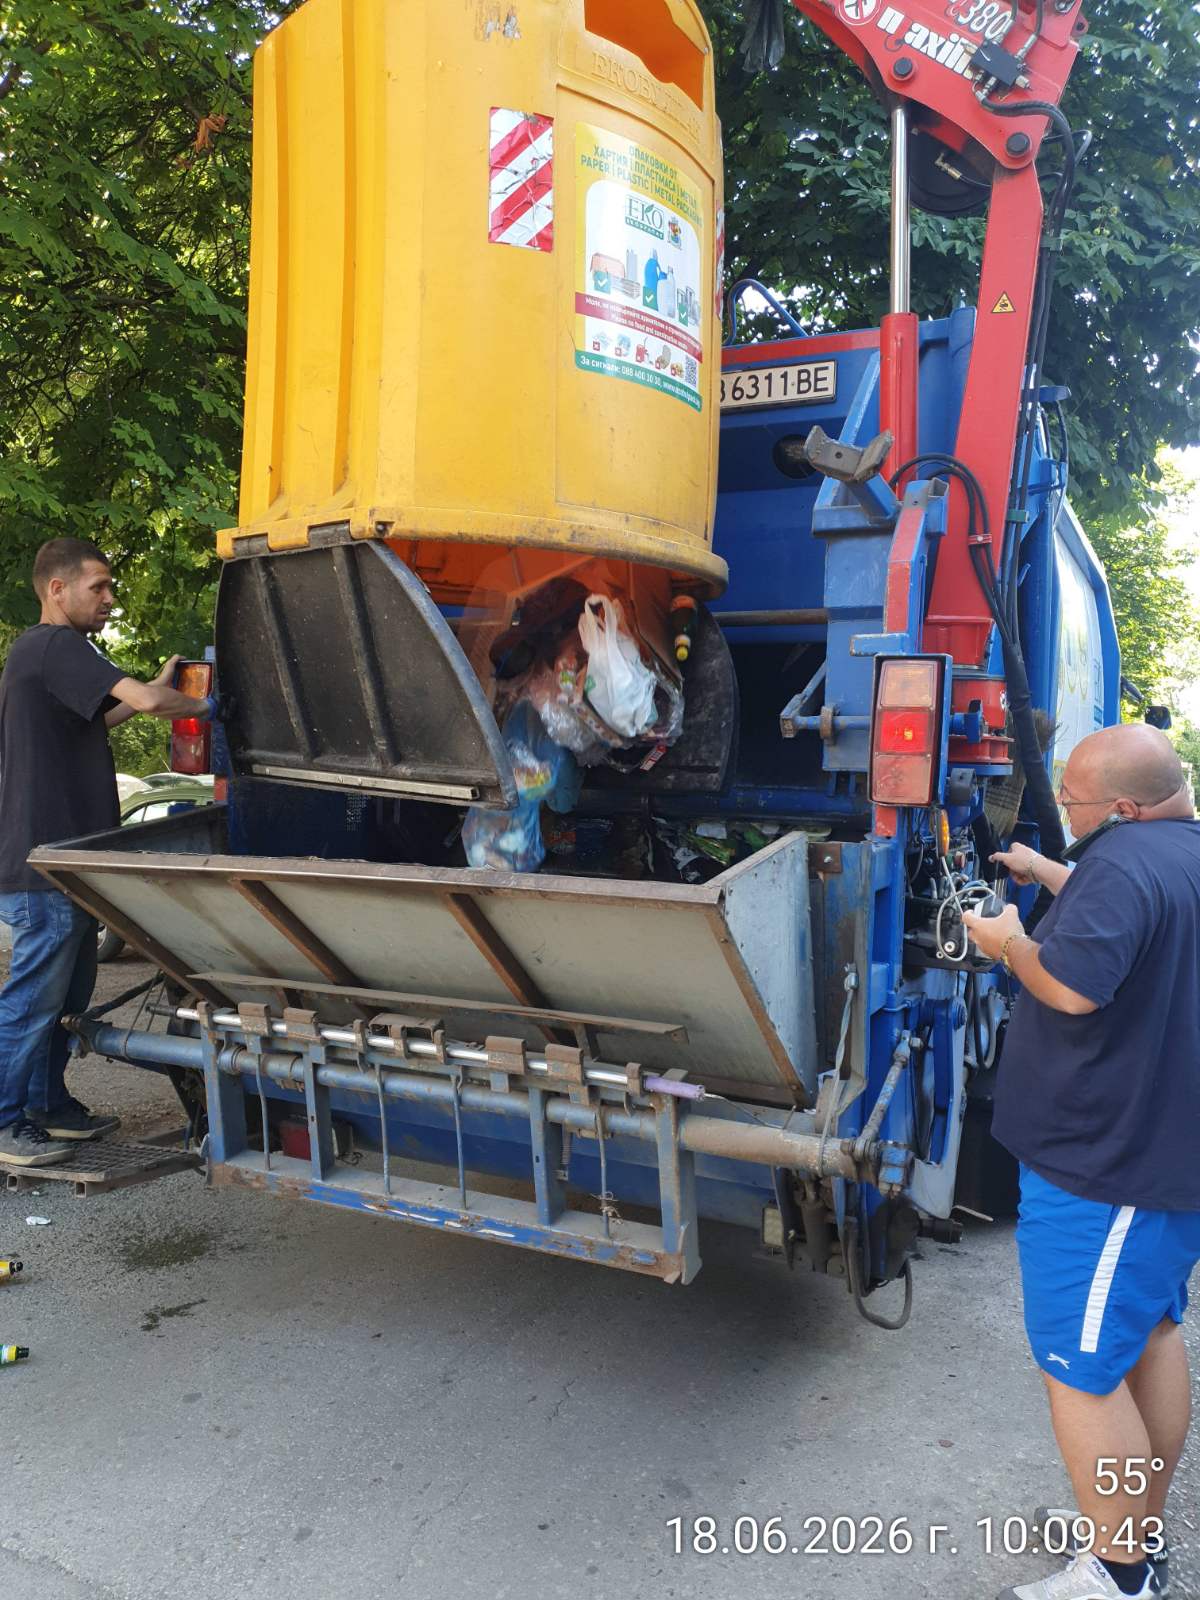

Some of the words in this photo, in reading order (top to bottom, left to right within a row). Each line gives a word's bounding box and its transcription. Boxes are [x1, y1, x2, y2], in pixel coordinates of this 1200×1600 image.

[593, 145, 628, 166] ХАРТИЯ
[581, 154, 610, 173] PAPER
[617, 167, 649, 190] PLASTIC
[580, 355, 590, 366] За
